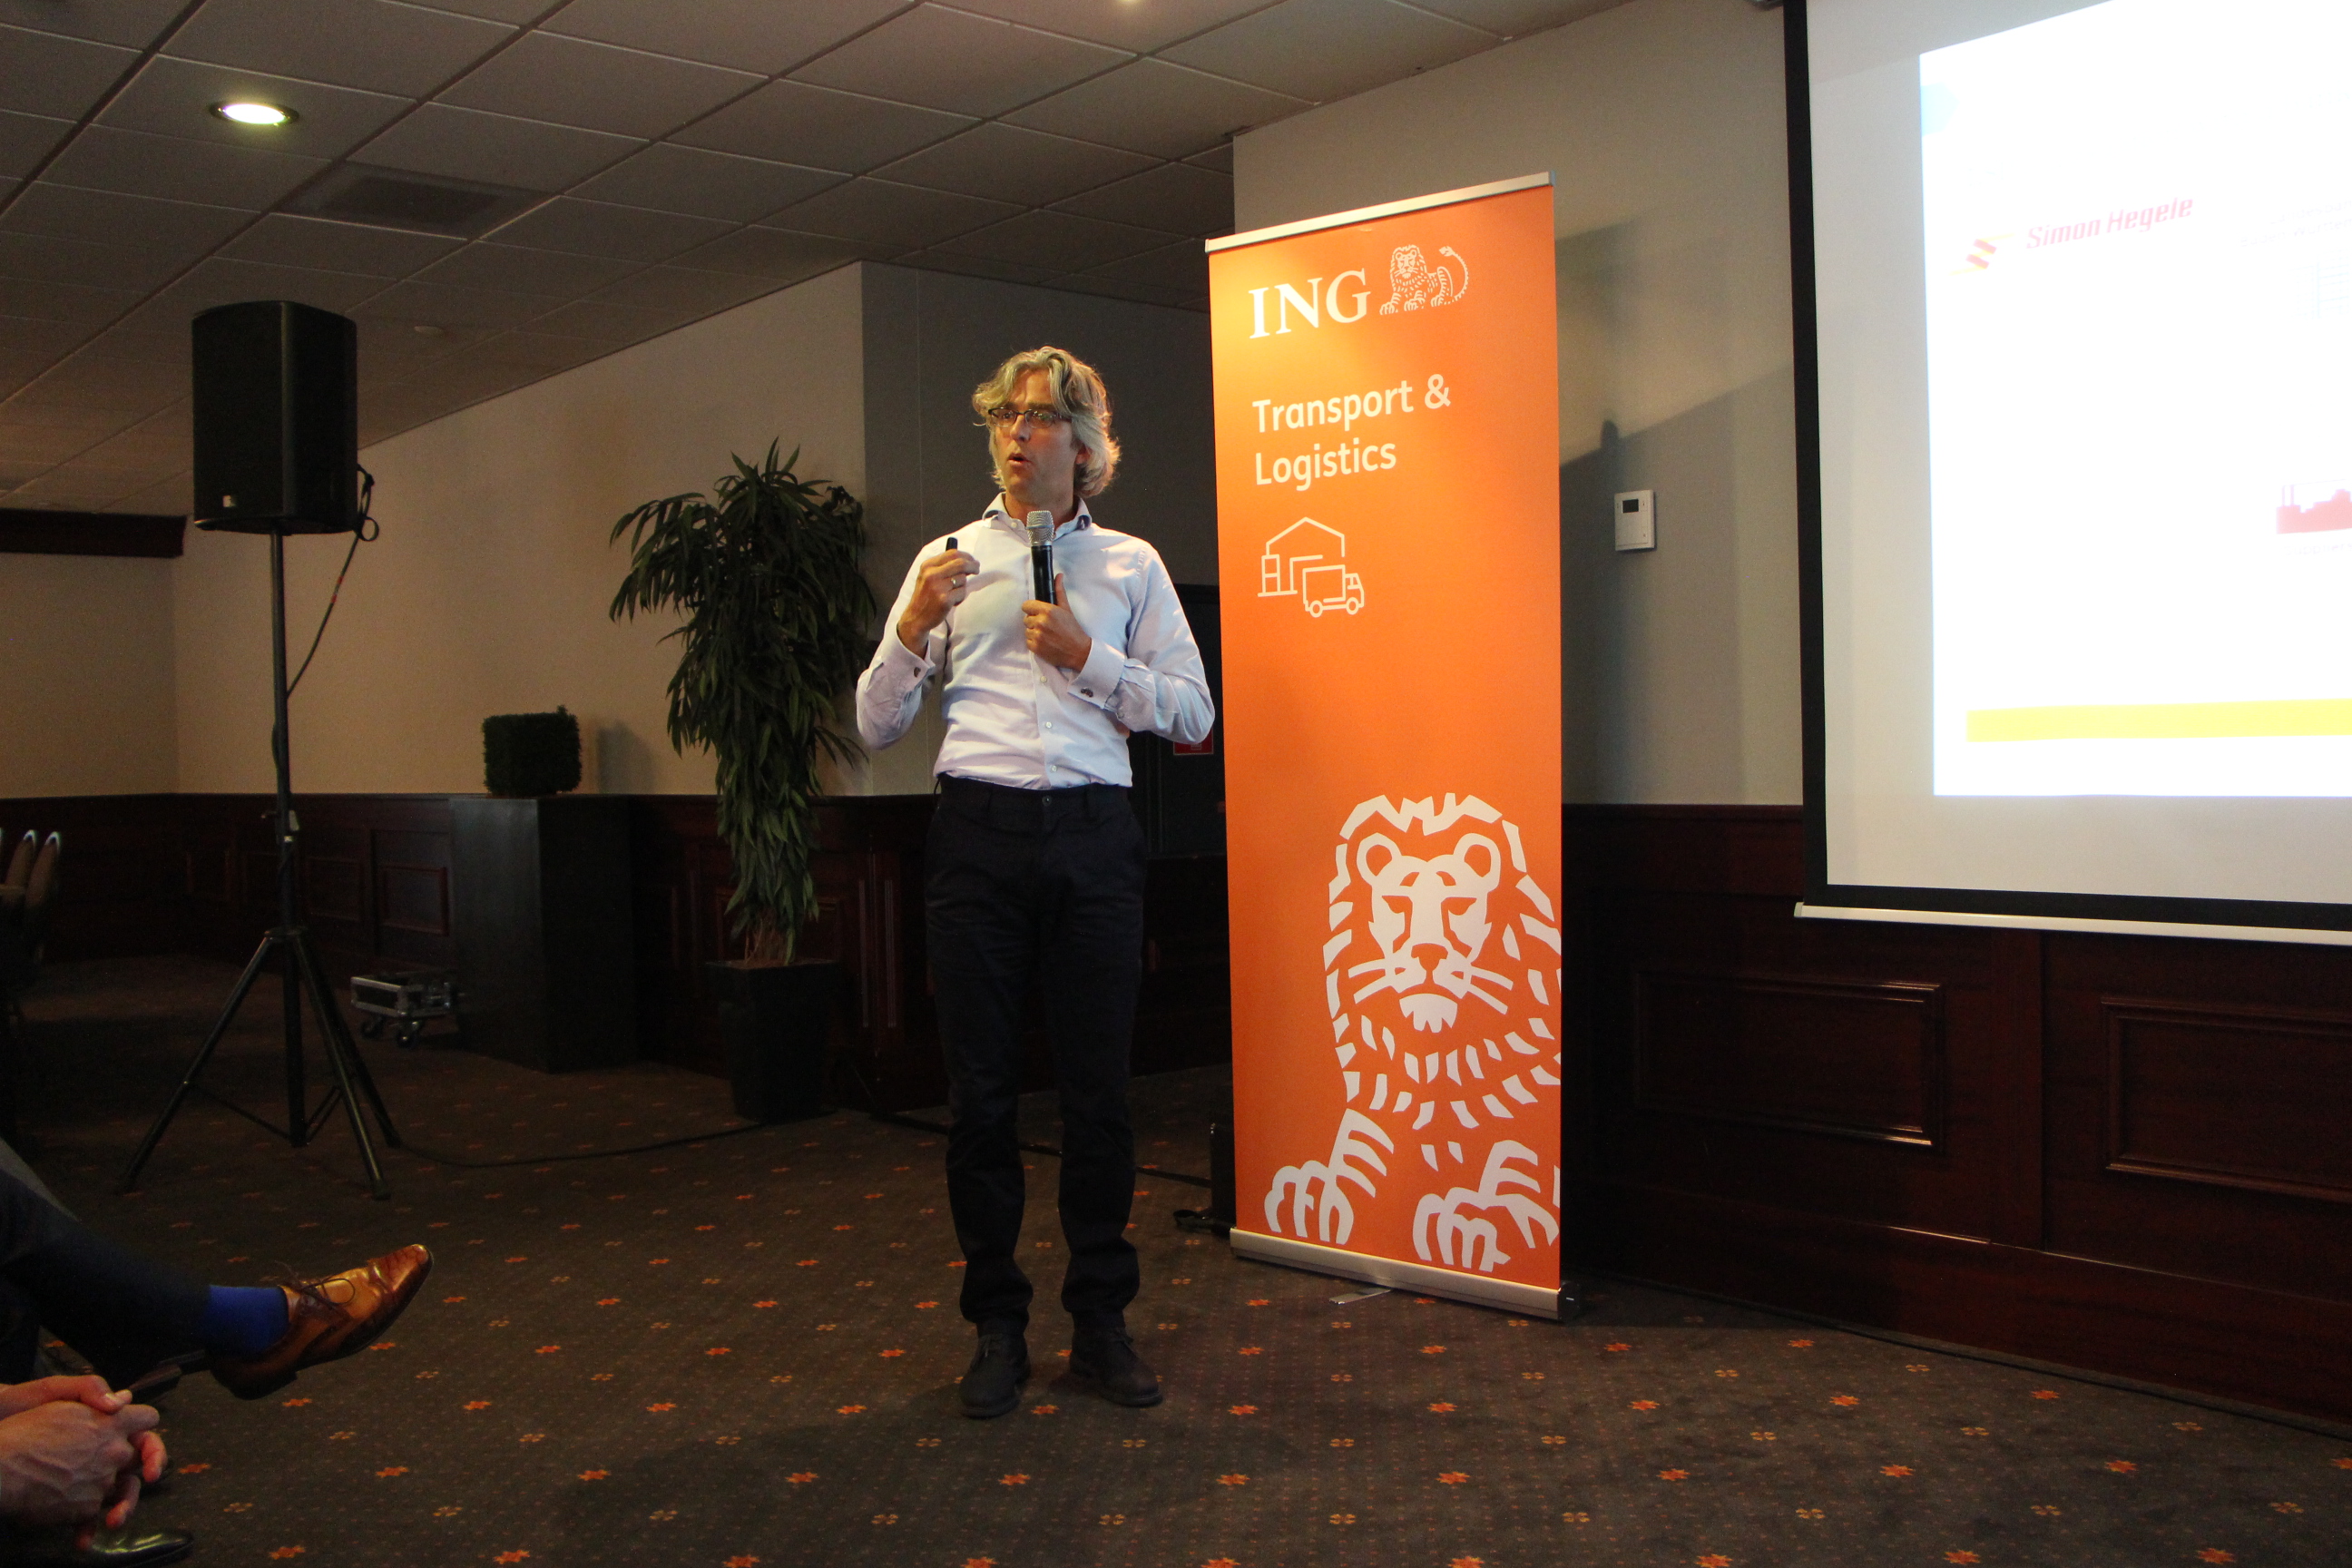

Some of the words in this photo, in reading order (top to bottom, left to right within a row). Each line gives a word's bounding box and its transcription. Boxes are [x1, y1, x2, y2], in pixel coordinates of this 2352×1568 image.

[2025, 219, 2102, 250] Simon
[2106, 196, 2194, 233] Hegele
[1248, 268, 1371, 339] ING
[1251, 380, 1415, 432] Transport
[1424, 373, 1452, 409] &
[1254, 437, 1397, 492] Logistics
